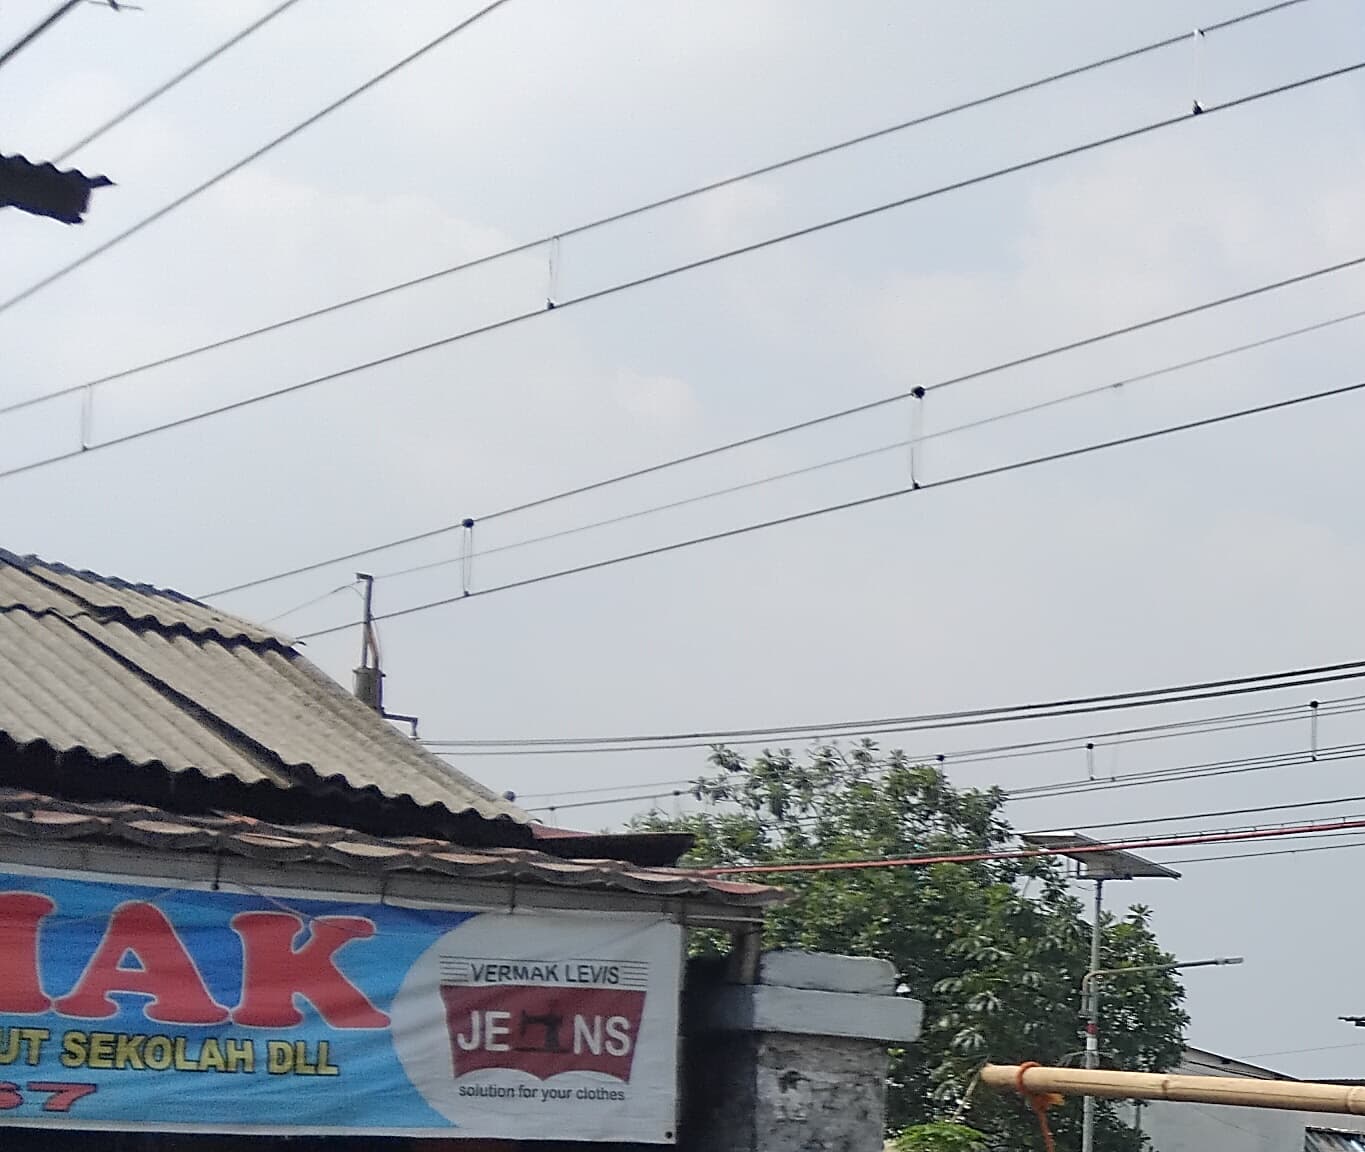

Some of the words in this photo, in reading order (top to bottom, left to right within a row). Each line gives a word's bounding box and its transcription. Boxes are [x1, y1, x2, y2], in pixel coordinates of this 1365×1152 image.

[472, 963, 559, 983] VERMAK
[565, 965, 619, 985] LEVIS
[60, 1029, 254, 1075] SEKOLAH
[267, 1039, 340, 1077] DLL
[458, 1084, 515, 1098] solution
[518, 1084, 538, 1099] for
[541, 1087, 572, 1102] your
[576, 1085, 625, 1101] clothes
